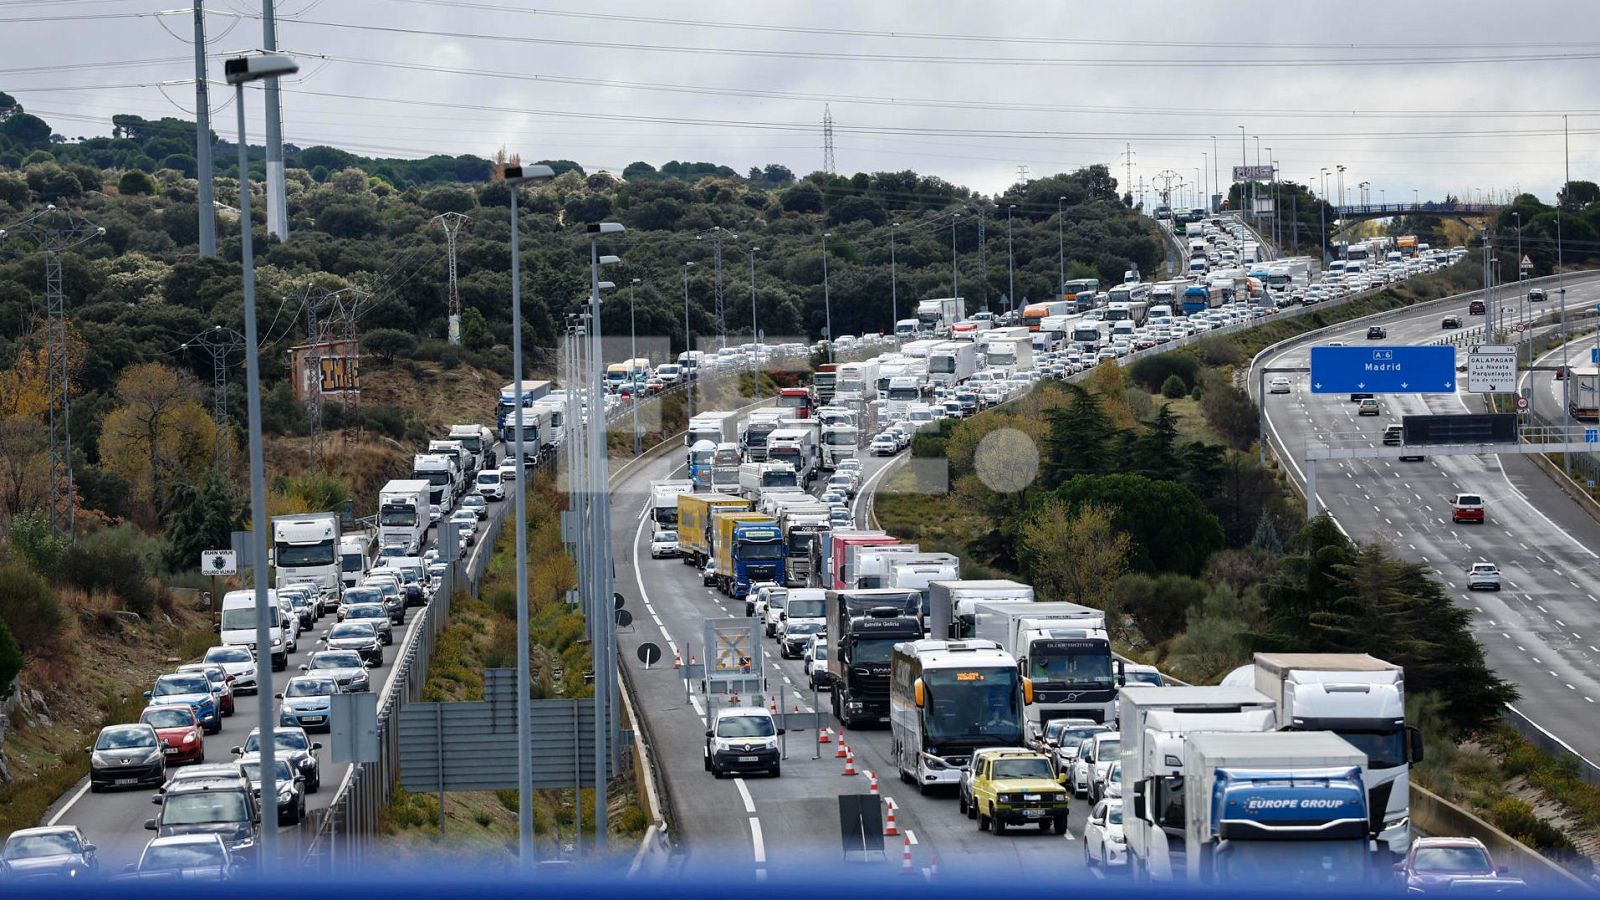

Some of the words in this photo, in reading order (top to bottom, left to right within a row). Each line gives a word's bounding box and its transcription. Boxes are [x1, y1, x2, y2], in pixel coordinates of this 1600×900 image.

[1365, 363, 1401, 371] Madrid
[1248, 799, 1298, 809] EUROPE
[1300, 799, 1344, 809] GROUP
